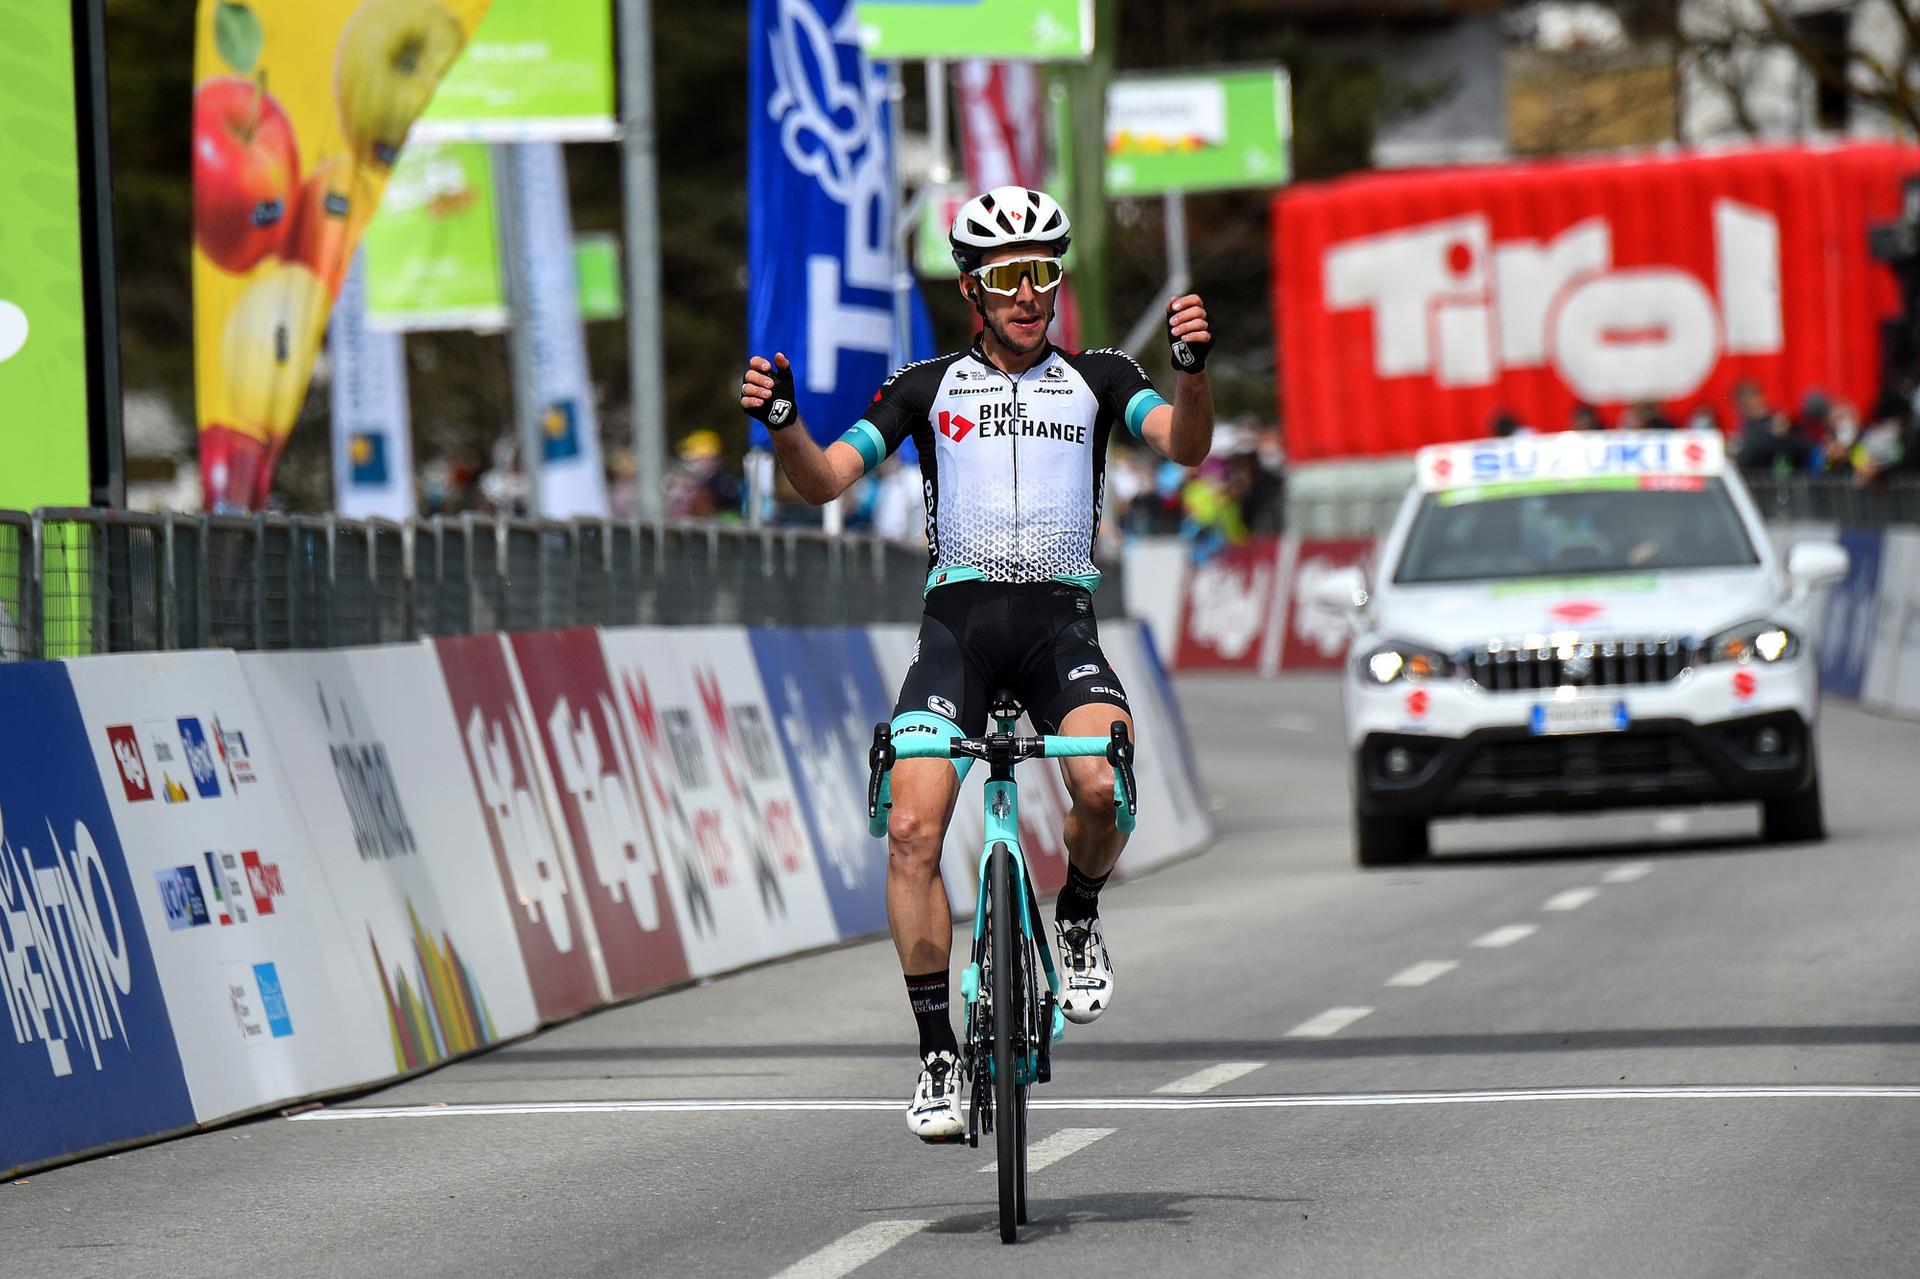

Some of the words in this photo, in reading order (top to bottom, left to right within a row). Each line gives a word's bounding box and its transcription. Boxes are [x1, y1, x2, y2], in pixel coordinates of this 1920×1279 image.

[1325, 198, 1783, 405] Tirol
[949, 386, 1004, 396] Bianchi
[1033, 387, 1073, 395] Jayco
[979, 402, 1028, 420] BIKE
[979, 418, 1087, 445] EXCHANGE
[891, 724, 938, 740] nchi
